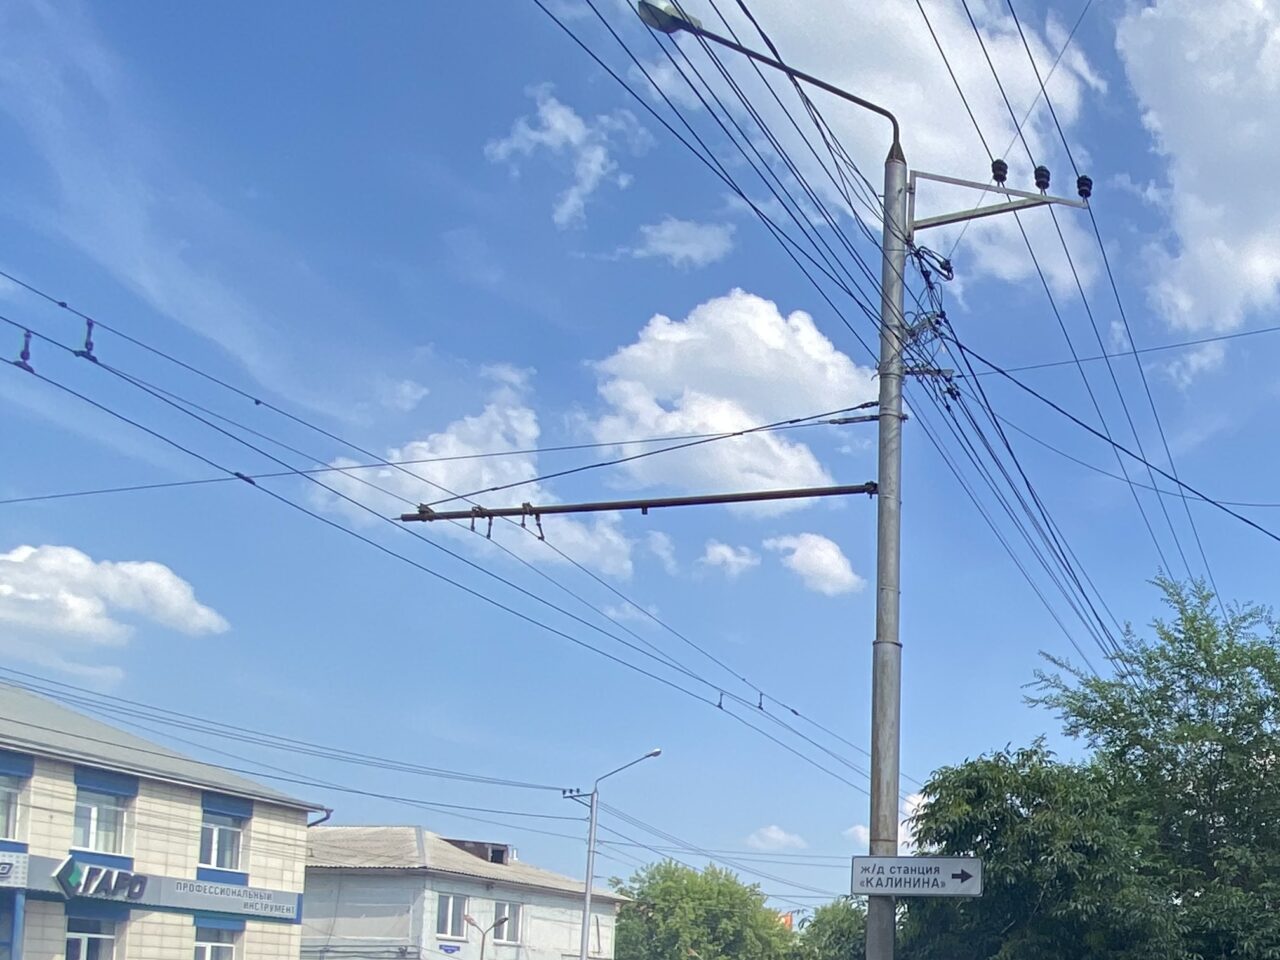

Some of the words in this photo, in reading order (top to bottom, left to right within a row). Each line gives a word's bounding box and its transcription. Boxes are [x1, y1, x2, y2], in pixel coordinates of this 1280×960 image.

[860, 863, 885, 876] ж/д
[889, 865, 940, 876] станция
[79, 865, 148, 900] ГАРО
[860, 877, 946, 889] «КАЛИНИНА»
[176, 881, 273, 901] ПРОФЕССИОНАЛЬНЫЙ
[243, 902, 295, 914] ИНСТРУМЕНТ
